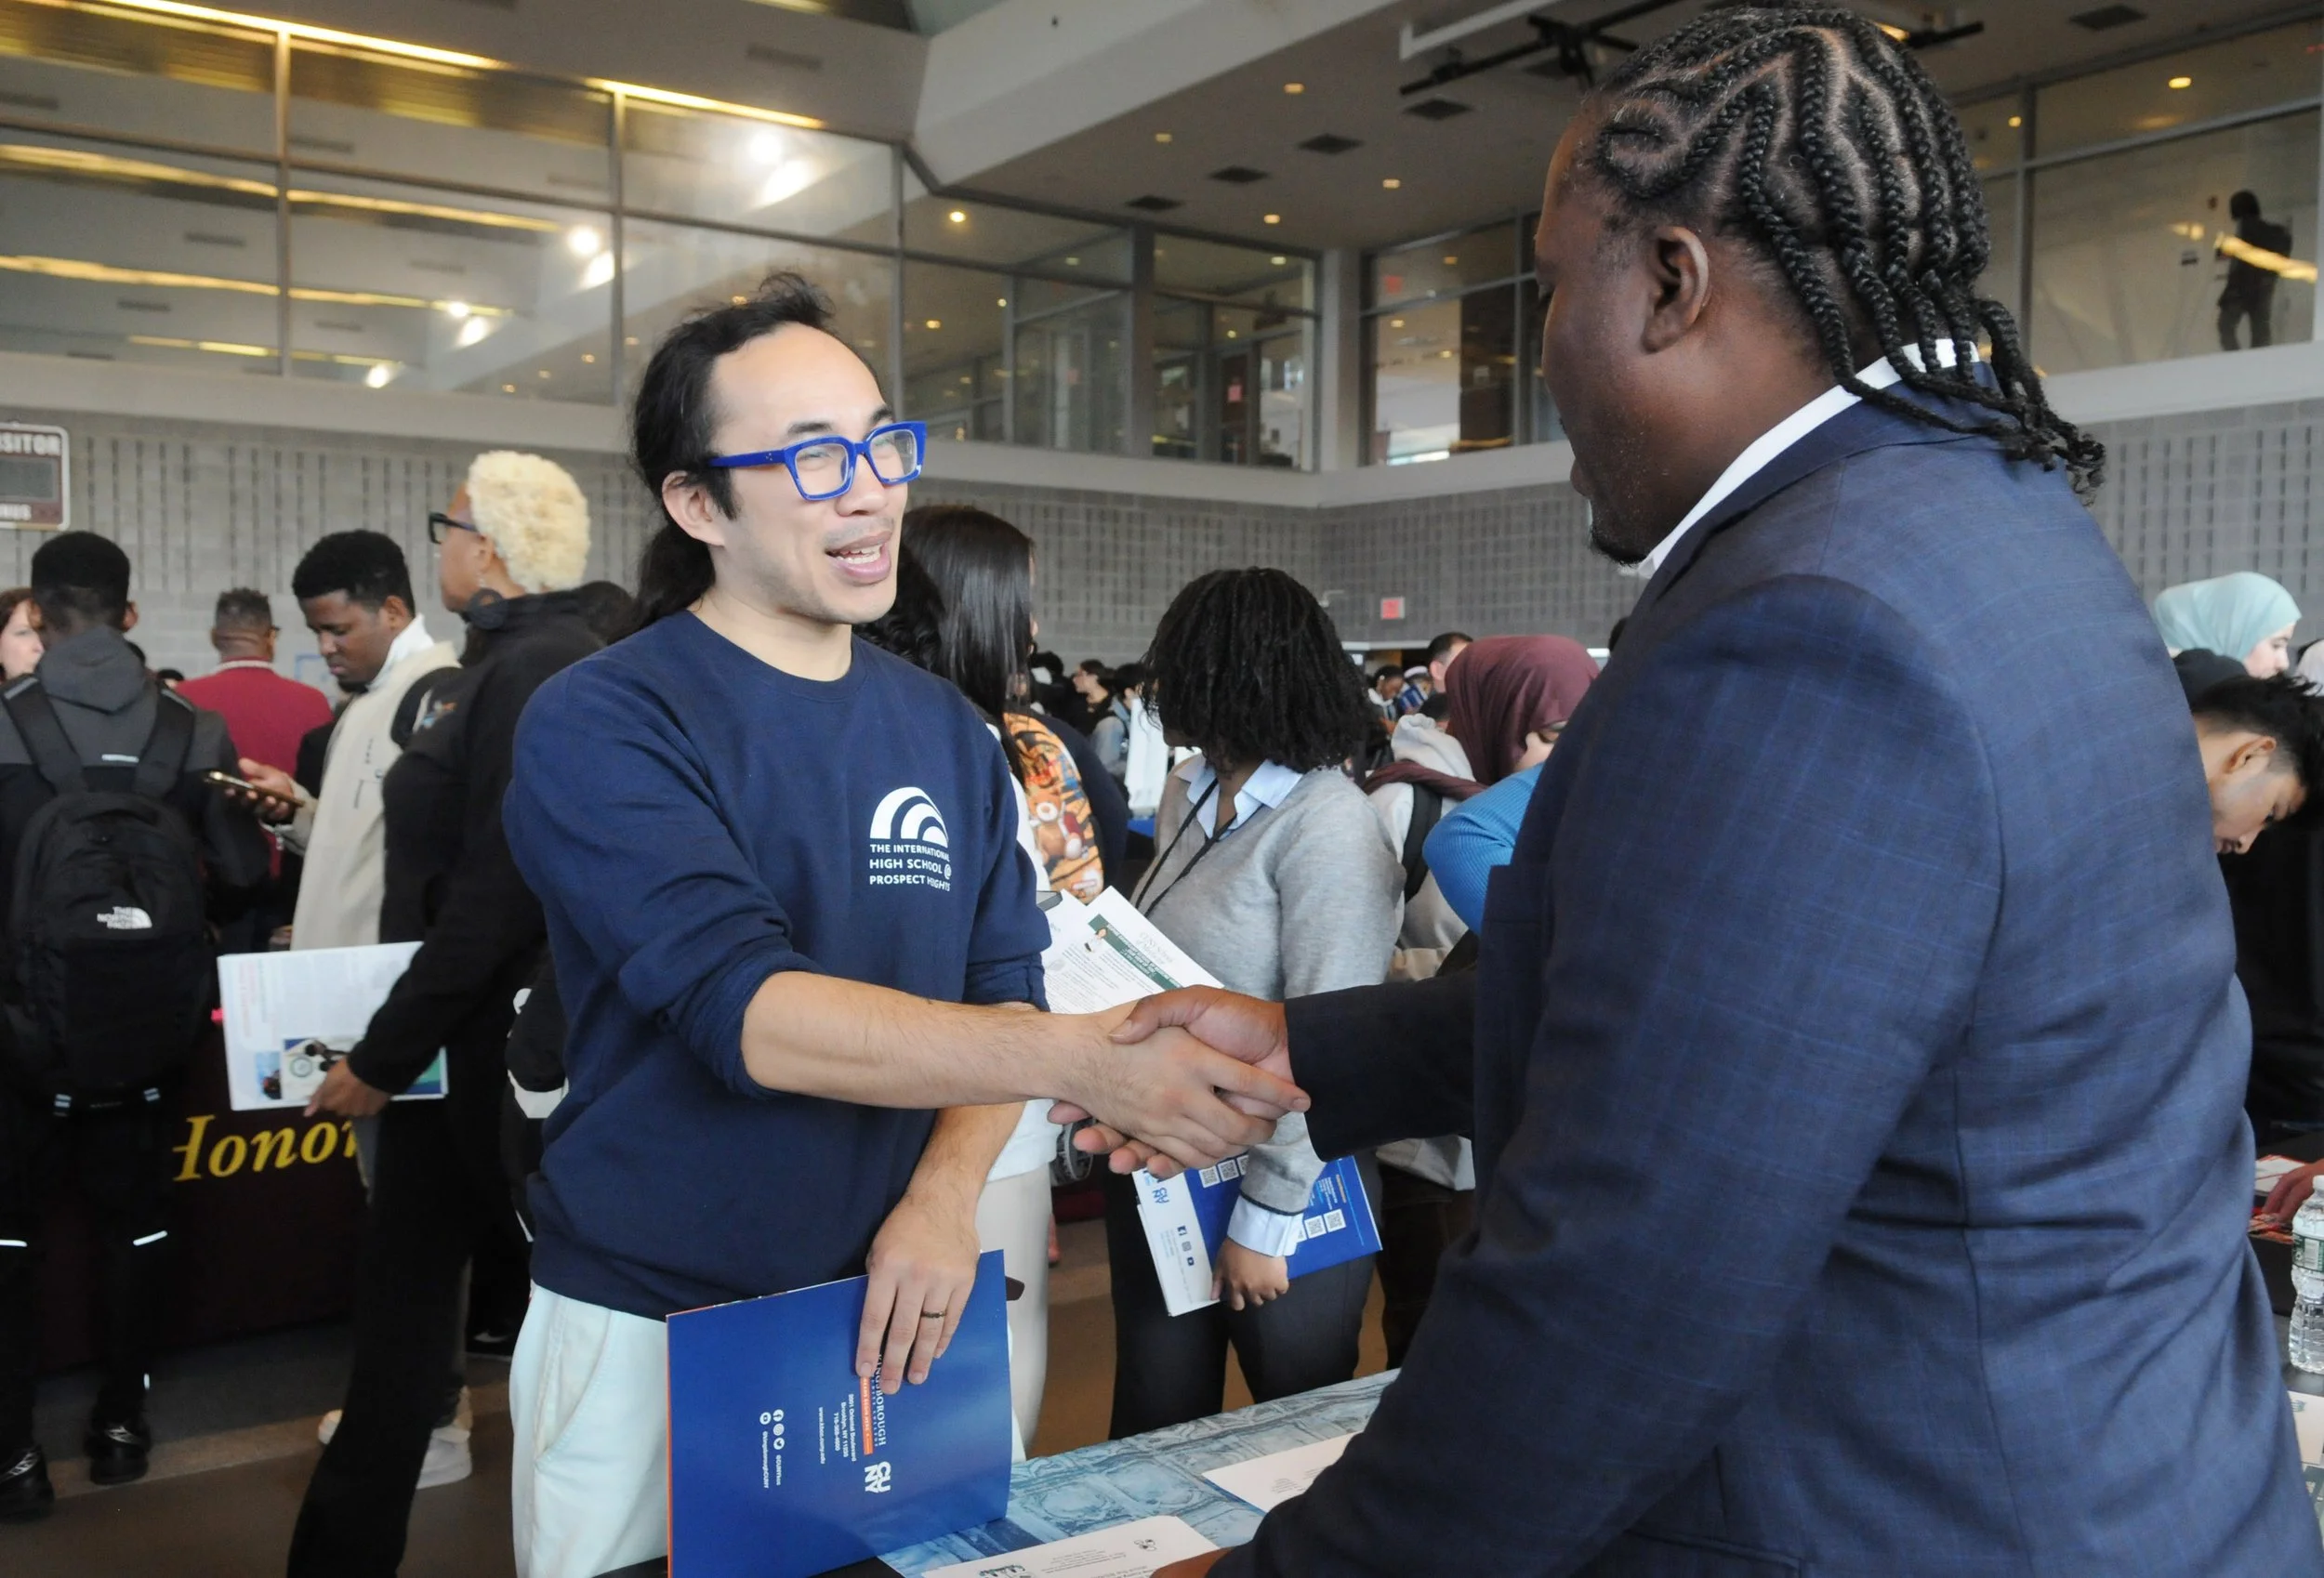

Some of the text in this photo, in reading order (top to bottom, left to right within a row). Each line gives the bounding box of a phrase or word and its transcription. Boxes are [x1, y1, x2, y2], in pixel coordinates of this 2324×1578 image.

[0, 432, 61, 456] SITOR
[870, 844, 891, 853] THE
[869, 858, 904, 869] HIGH
[907, 859, 943, 874] SCHOOL
[869, 874, 926, 885] PROSPECT
